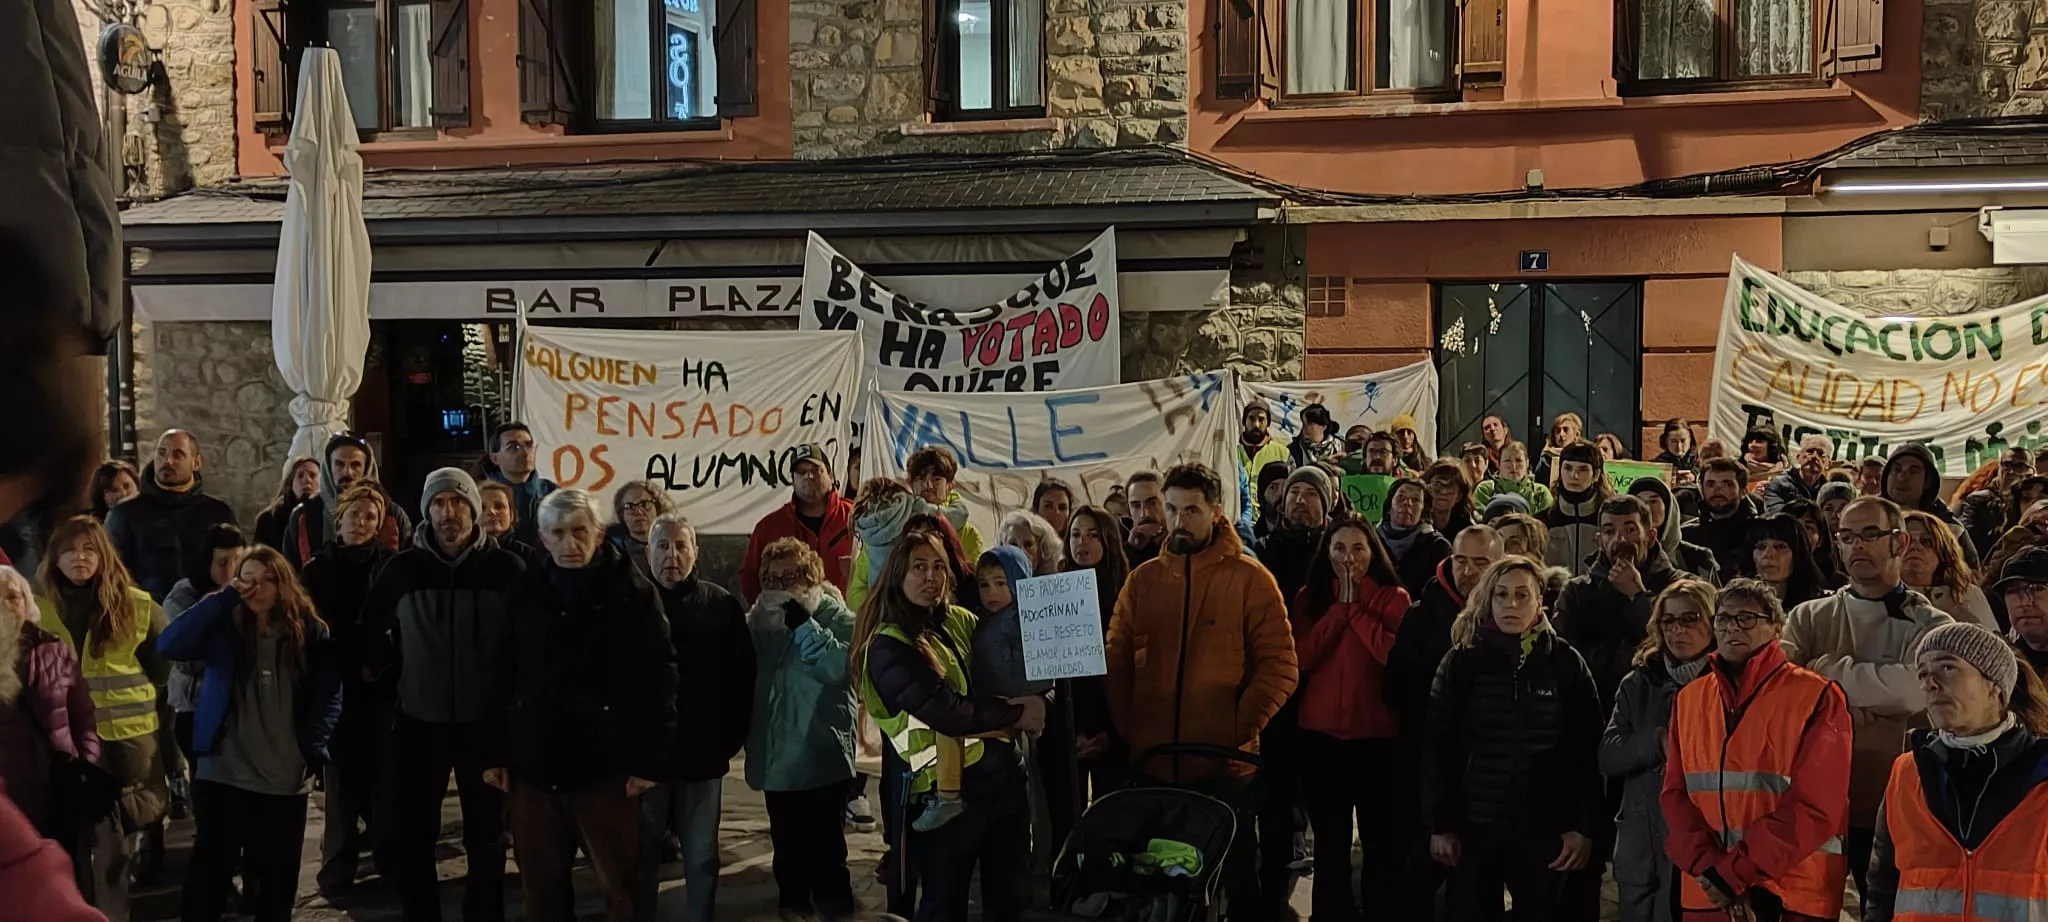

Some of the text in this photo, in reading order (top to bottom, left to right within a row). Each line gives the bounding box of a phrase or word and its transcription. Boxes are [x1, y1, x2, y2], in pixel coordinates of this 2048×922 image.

[1529, 253, 1540, 269] 7
[486, 284, 803, 313] BAR PLAZA
[1739, 276, 2003, 362] EDUCACION
[879, 319, 946, 370] HA
[963, 292, 1110, 368] VOTADO
[682, 357, 729, 394] HA
[1941, 369, 2001, 415] NO
[564, 391, 842, 441] PENSADO EN
[882, 393, 1108, 470] VALLE
[1076, 575, 1092, 591] ME
